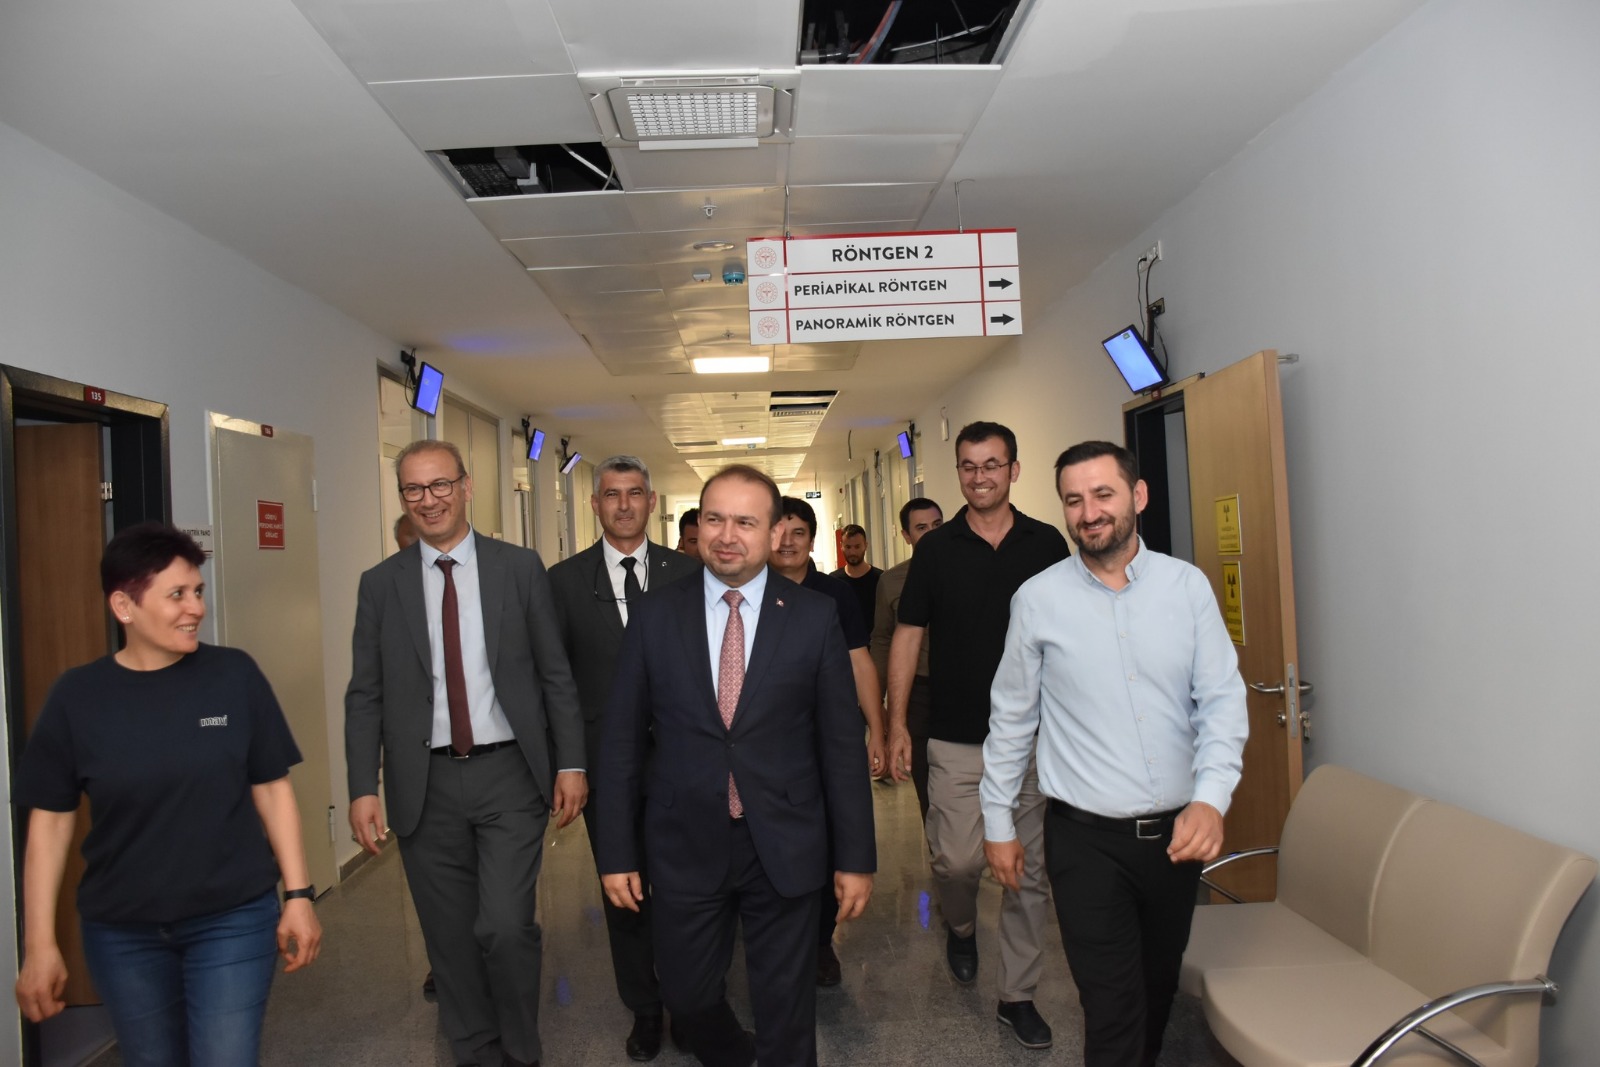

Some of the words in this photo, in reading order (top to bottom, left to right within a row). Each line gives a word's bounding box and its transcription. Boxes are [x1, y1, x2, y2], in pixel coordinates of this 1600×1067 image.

[832, 245, 919, 262] RÖNTGEN
[924, 245, 934, 259] 2
[794, 280, 875, 297] PERİAPİKAL
[878, 279, 948, 294] RÖNTGEN
[795, 312, 882, 331] PANORAMİK
[886, 312, 955, 328] RÖNTGEN
[91, 391, 102, 401] 135
[200, 714, 228, 727] mavi
